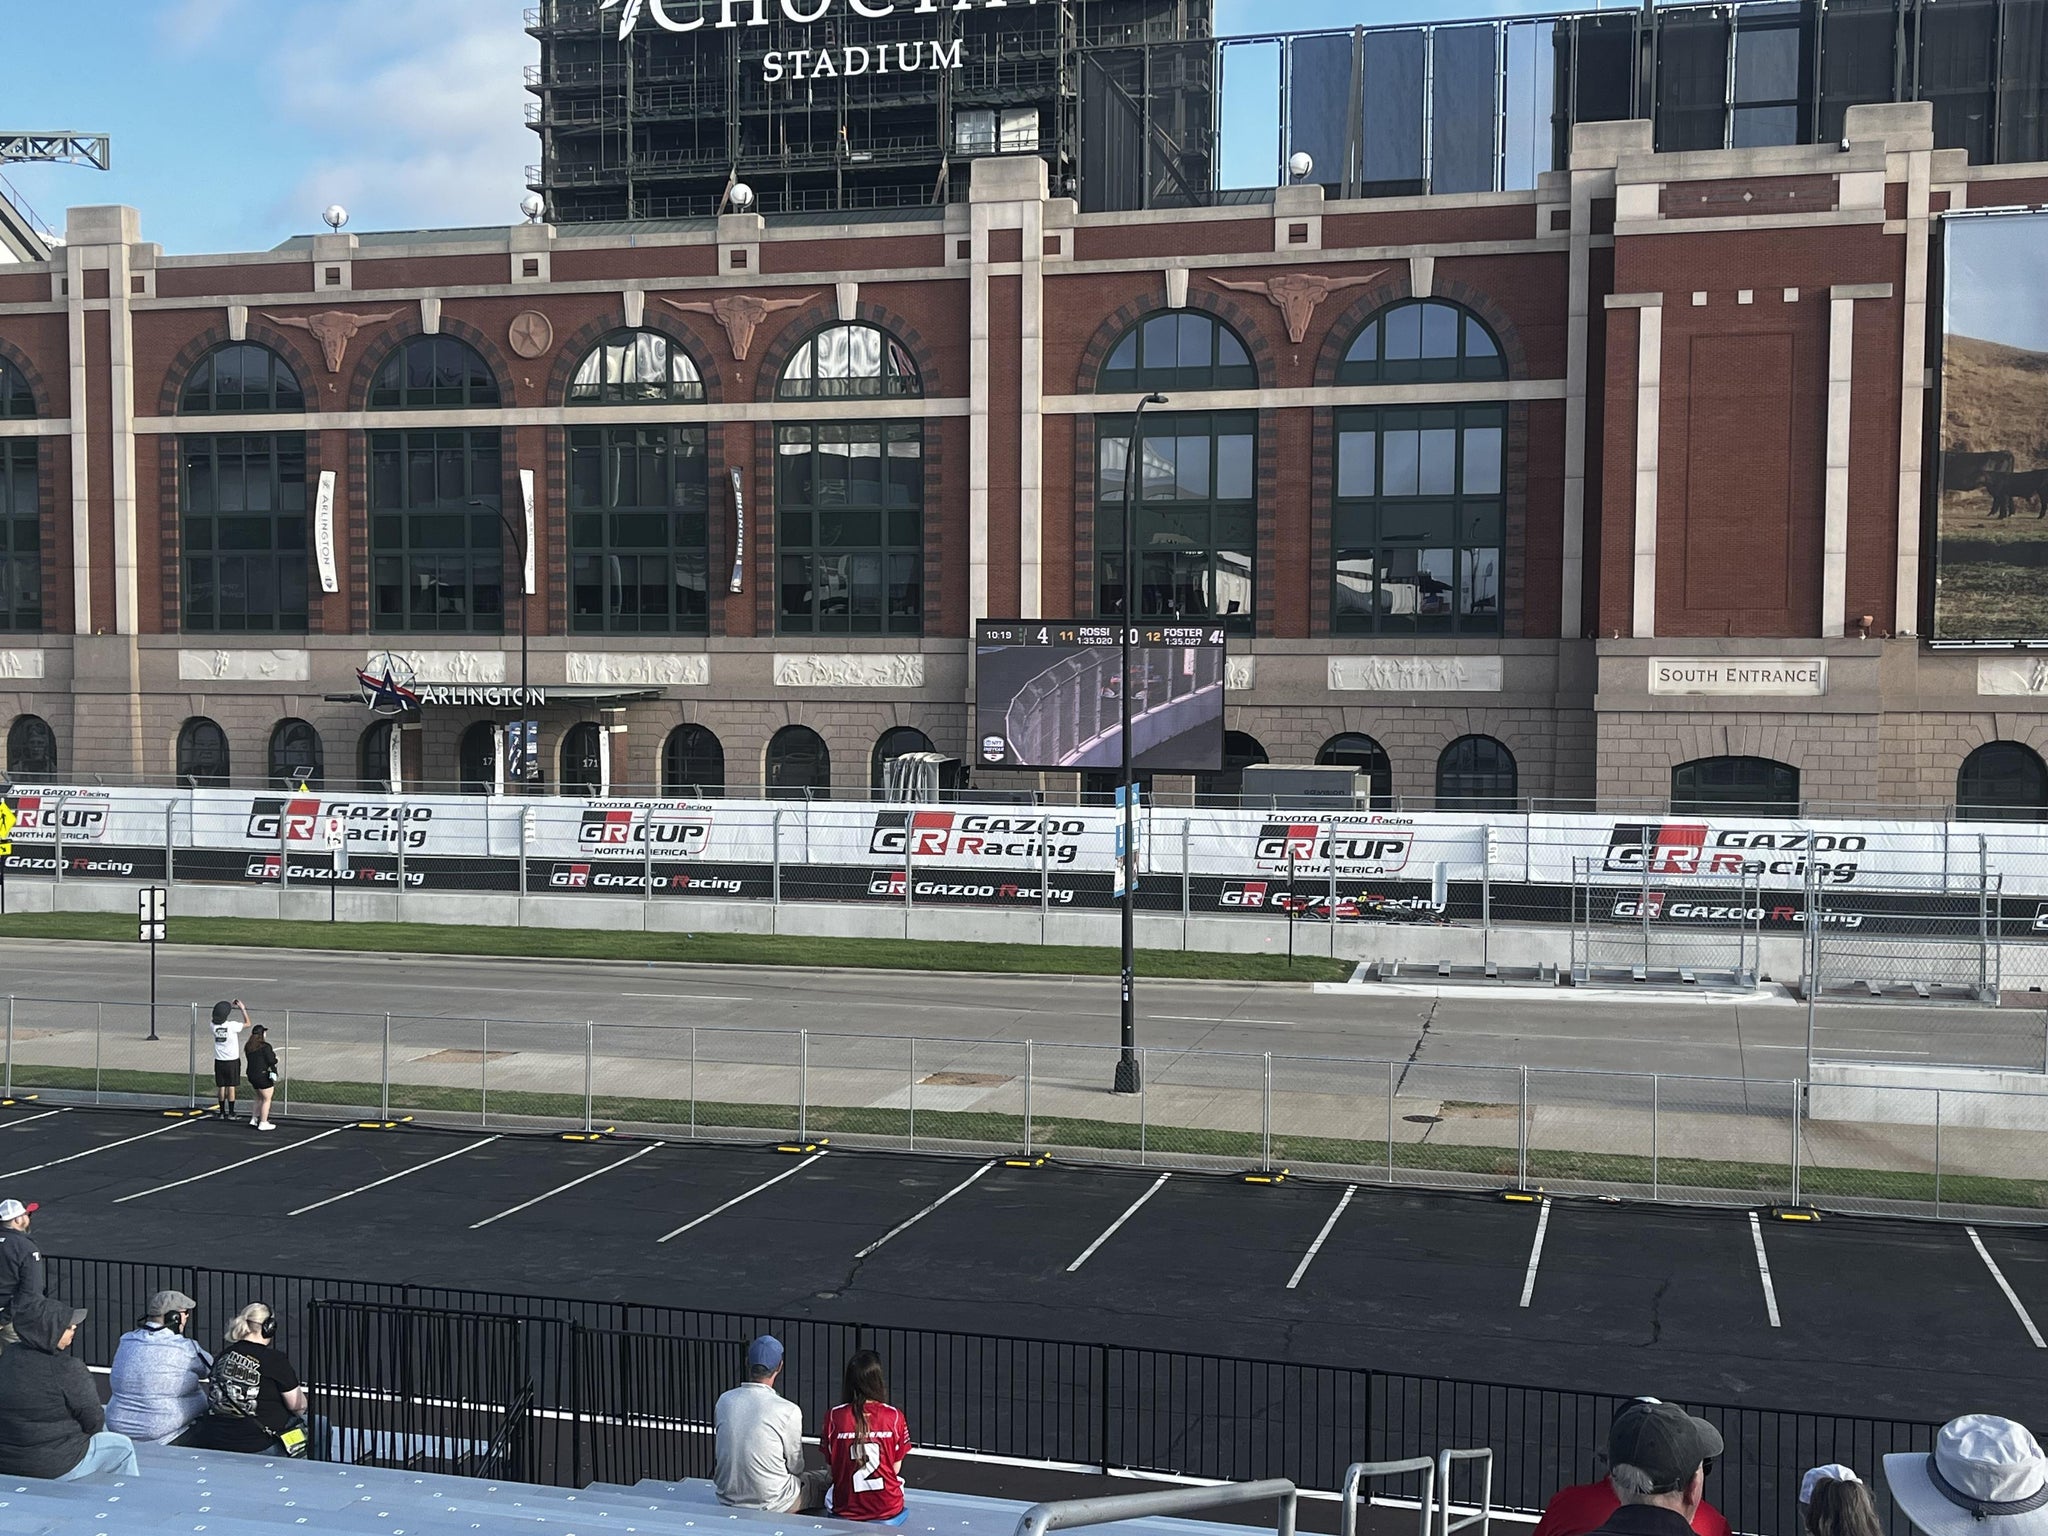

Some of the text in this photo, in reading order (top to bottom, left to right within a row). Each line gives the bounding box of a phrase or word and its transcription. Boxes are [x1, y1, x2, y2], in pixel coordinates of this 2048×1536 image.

[763, 39, 964, 82] STADIUM
[321, 495, 330, 565] ARLINGTON
[986, 631, 1012, 639] 10:19
[1037, 627, 1049, 644] 4
[1060, 628, 1110, 641] 11 ROSSI
[1077, 637, 1112, 645] 1:35.020
[1146, 628, 1203, 641] 12 FOSTER
[1165, 637, 1201, 645] 1:35.027
[1659, 668, 1818, 683] SOUTH ENTRANCE
[421, 685, 546, 706] ARLINGTON
[583, 759, 598, 768] 171
[43, 788, 76, 796] GAZOO
[79, 789, 110, 798] Racing
[327, 803, 433, 822] GAZOO
[587, 801, 712, 812] TOYOTA GAZOO Racing
[42, 811, 103, 828] CUP
[248, 814, 313, 840] GR
[961, 816, 1085, 836] GAZOO
[1266, 814, 1413, 825] TOYOTA GAZOO Racing
[579, 823, 704, 843] GR CUP
[873, 828, 948, 854] GR
[1717, 831, 1867, 852] GAZOO
[594, 847, 688, 856] NORTH AERICA
[957, 837, 1078, 864] Racing
[1257, 839, 1404, 860] GR CUP
[1608, 845, 1699, 871] GR
[4, 856, 133, 875] GAZOO Racing
[1274, 865, 1320, 873] NORTH
[1710, 853, 1858, 883] Racing
[593, 873, 667, 888] GAZOO
[672, 874, 741, 893] Racing
[915, 882, 994, 897] GAZOO
[1670, 904, 1765, 920] GAZOO
[850, 1443, 884, 1493] 2
